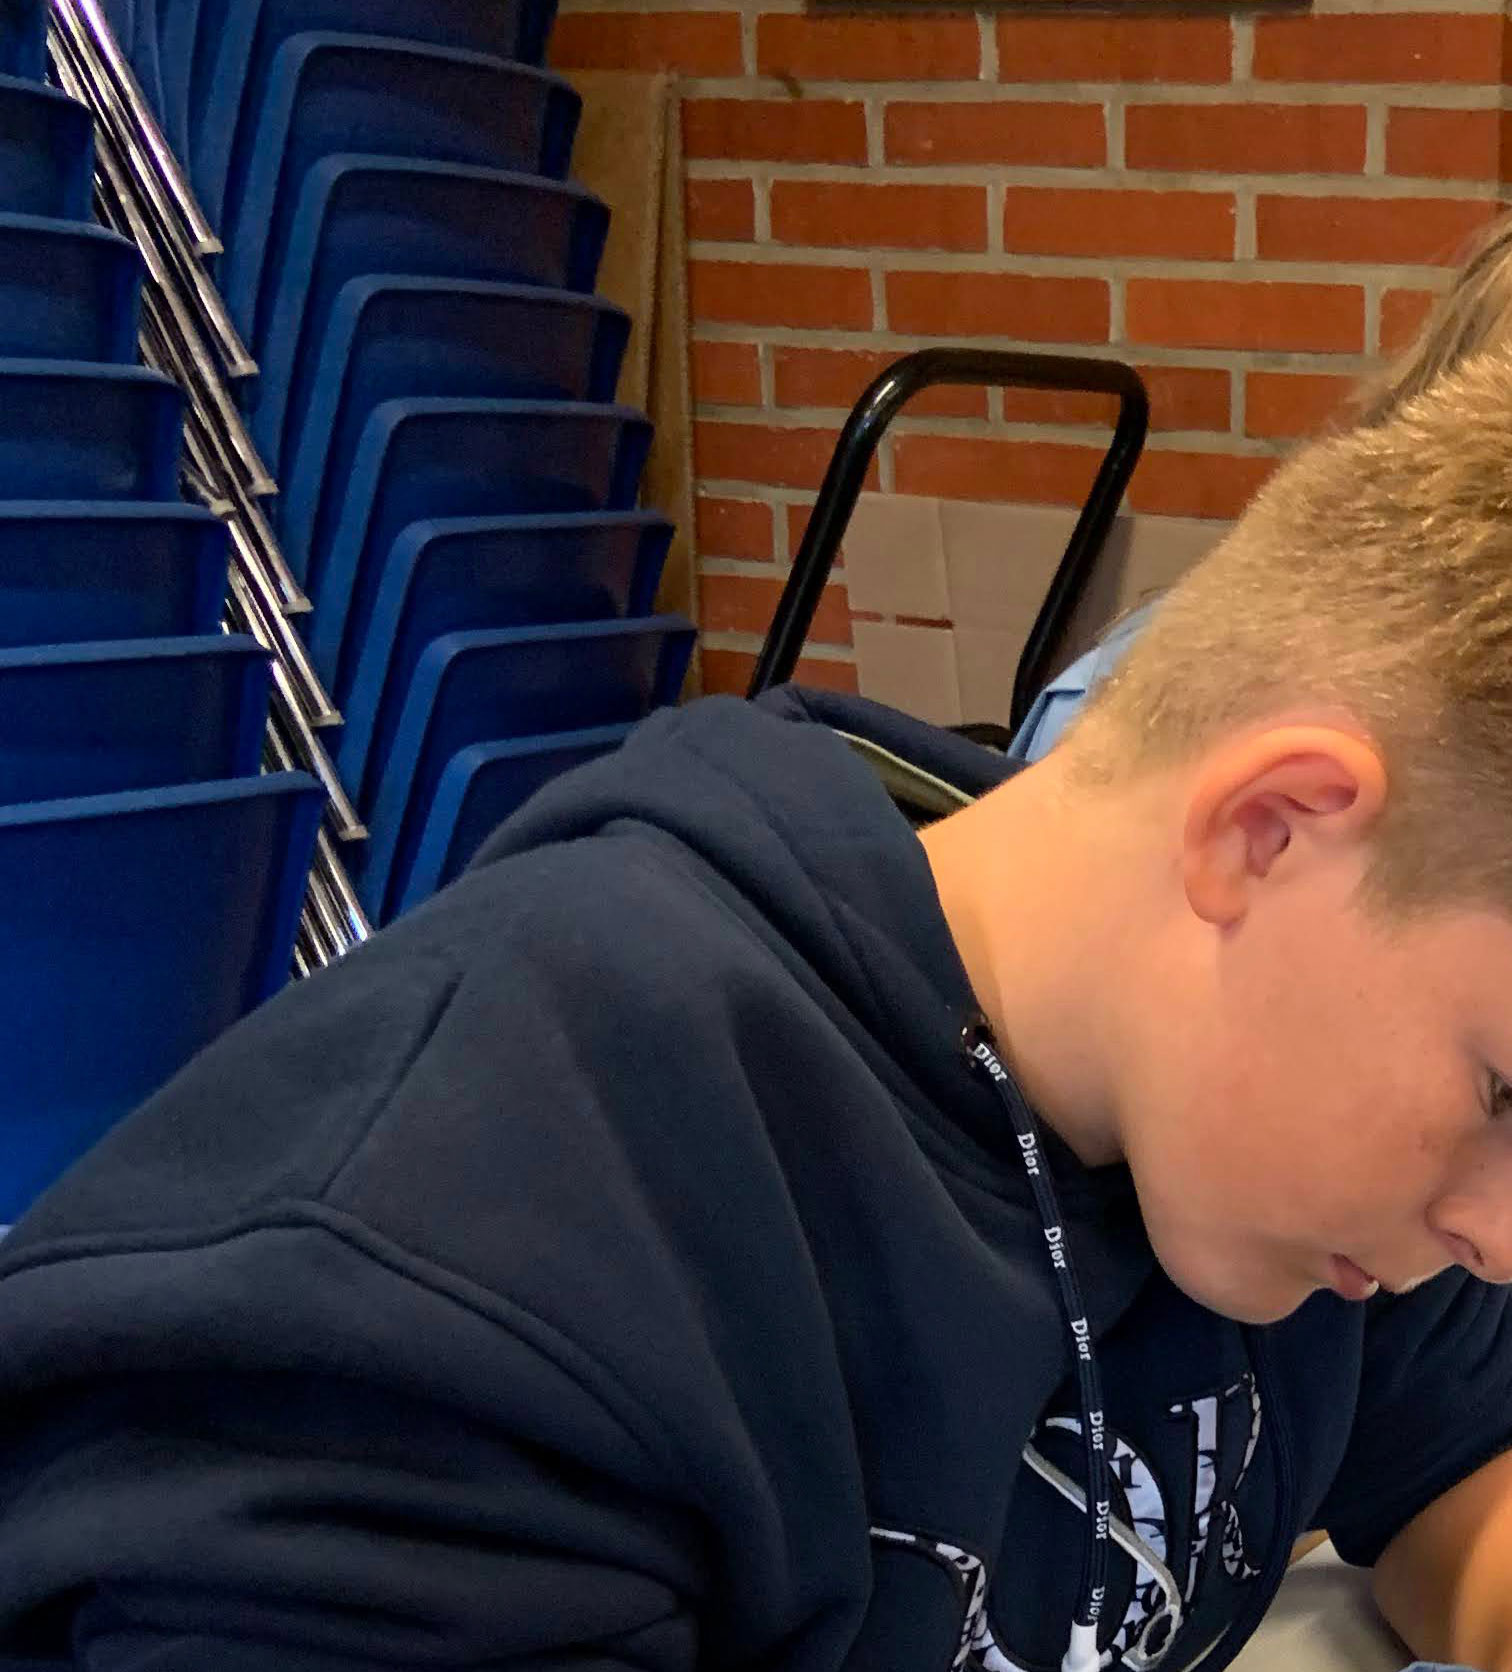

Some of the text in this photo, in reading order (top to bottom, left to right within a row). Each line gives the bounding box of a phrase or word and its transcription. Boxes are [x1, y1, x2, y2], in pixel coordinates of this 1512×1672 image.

[1017, 1132, 1040, 1177] Dior
[1043, 1225, 1066, 1269] Dior
[1071, 1316, 1092, 1361] Dior
[1089, 1409, 1105, 1451] Dior
[1095, 1500, 1110, 1541] Dior
